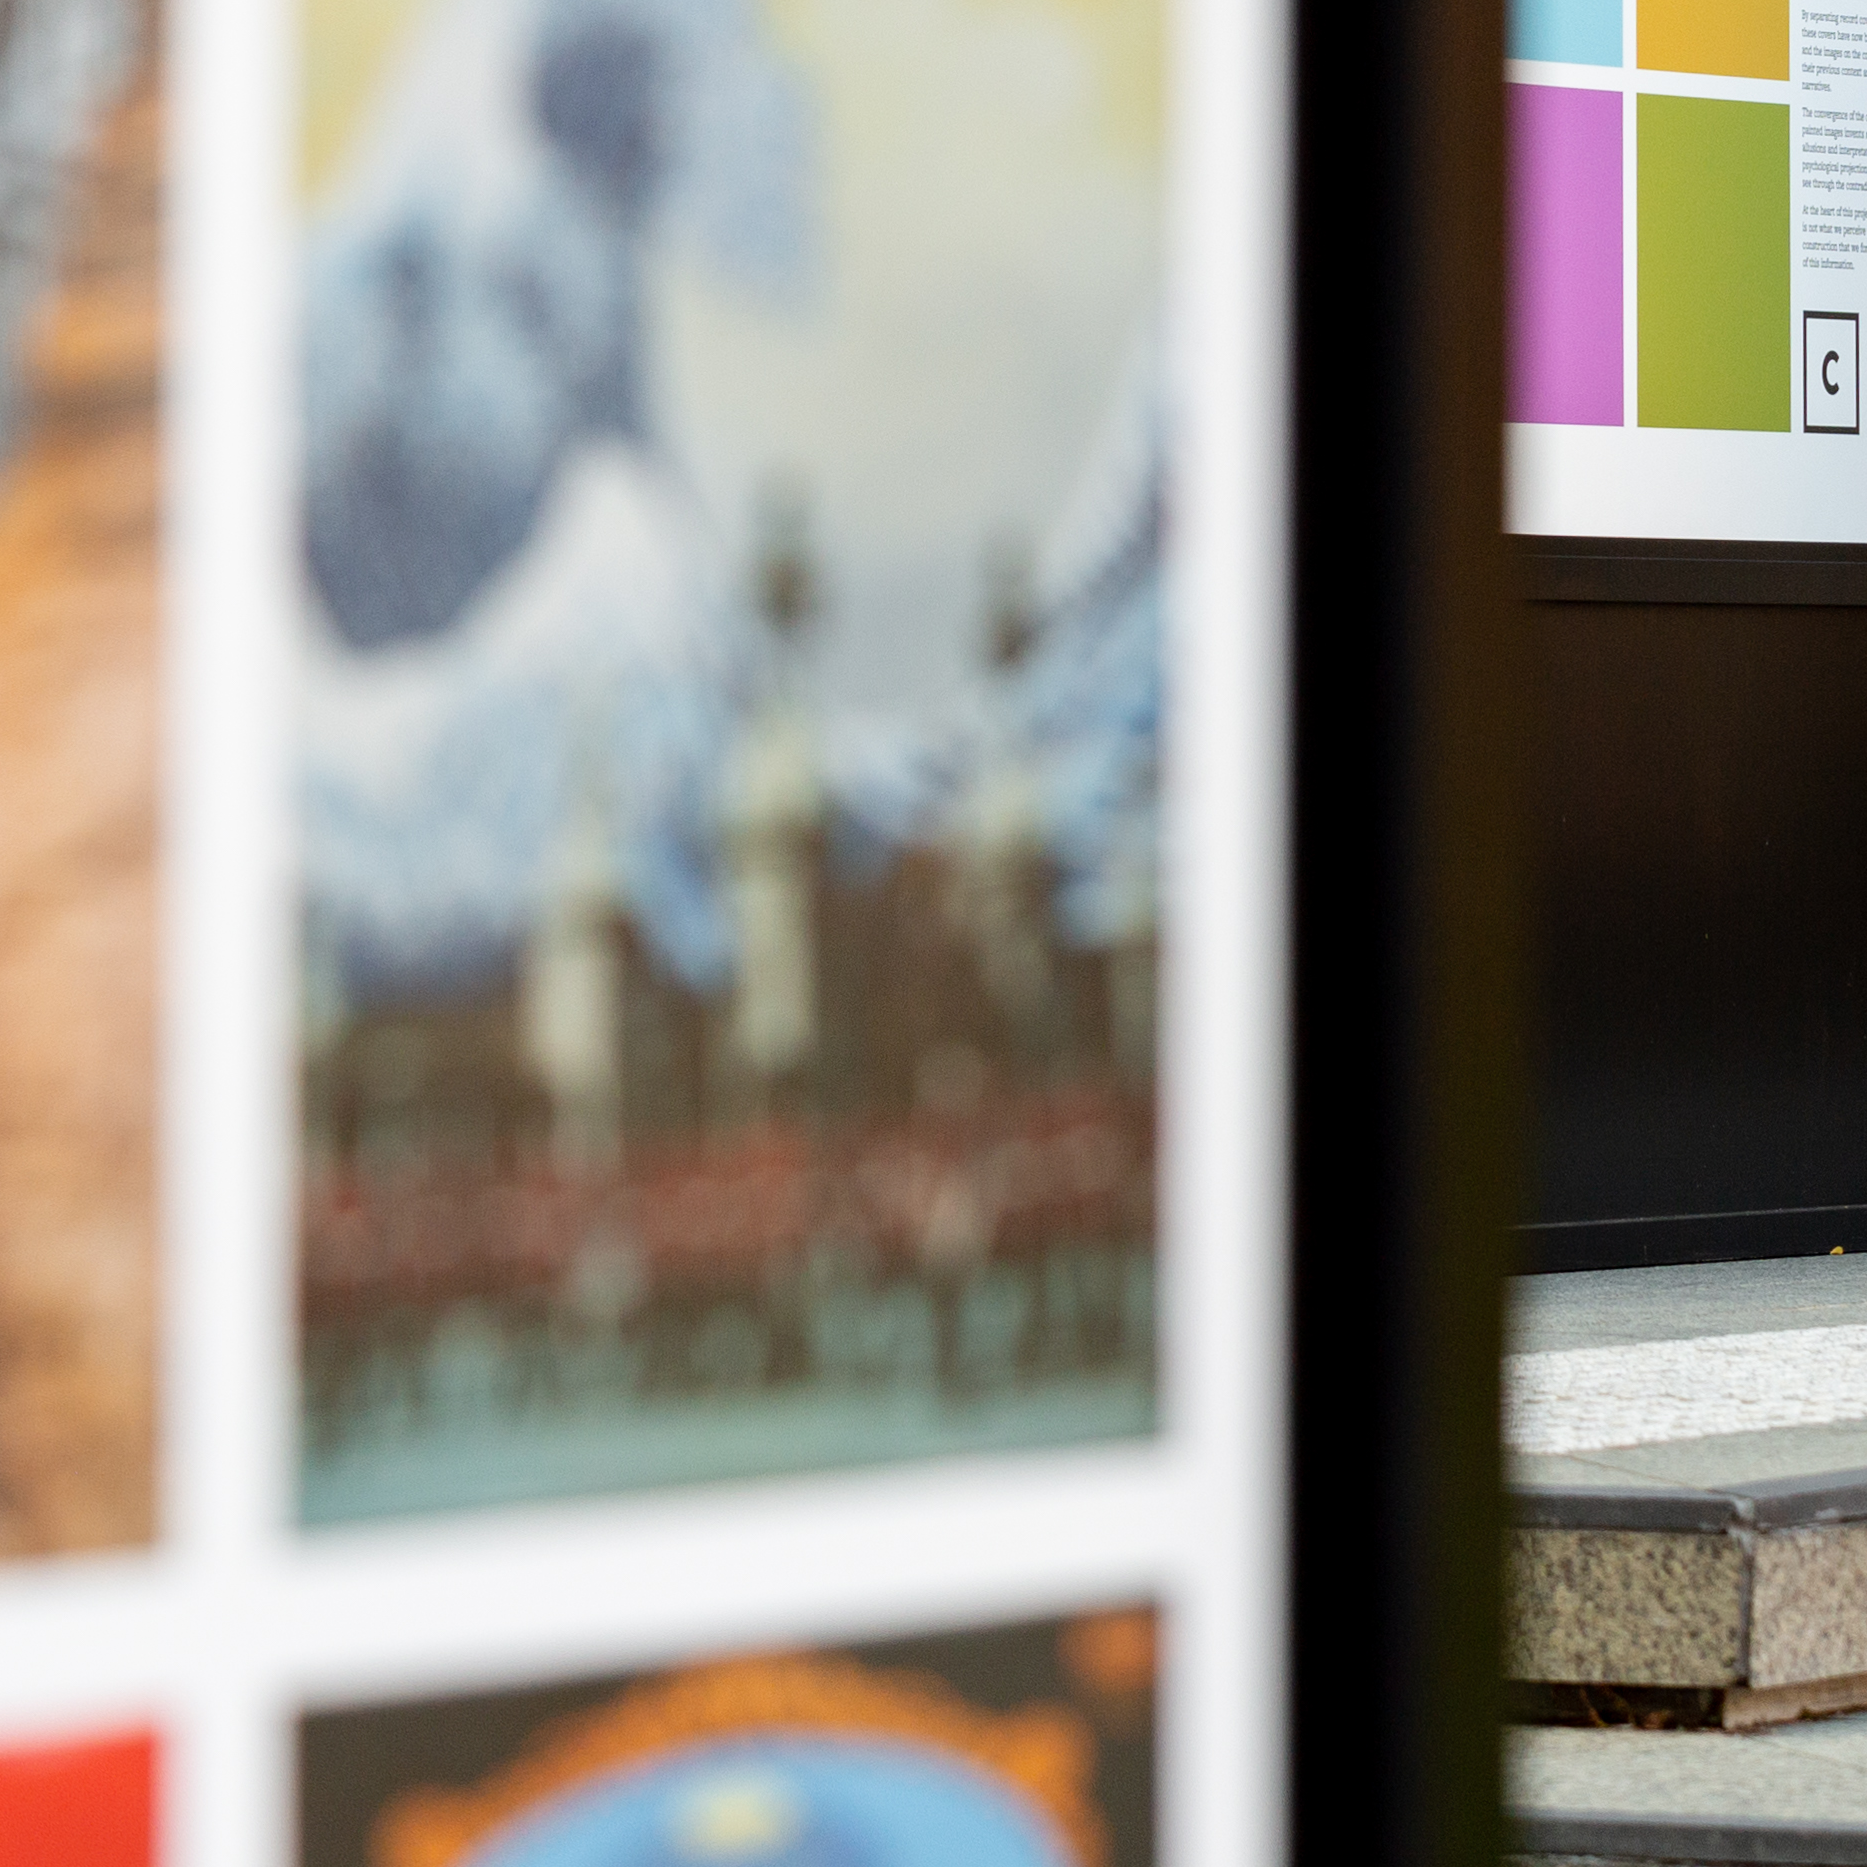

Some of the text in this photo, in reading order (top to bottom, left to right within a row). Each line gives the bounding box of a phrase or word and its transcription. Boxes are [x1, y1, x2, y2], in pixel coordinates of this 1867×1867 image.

[1810, 13, 1839, 27] separating
[1840, 14, 1858, 26] record
[1801, 27, 1817, 39] these
[1818, 31, 1836, 41] covers
[1823, 47, 1843, 61] images
[1801, 62, 1815, 74] their
[1816, 65, 1840, 77] previous
[1841, 67, 1862, 78] context
[1814, 110, 1848, 123] convergence
[1802, 126, 1823, 138] painted
[1824, 127, 1843, 141] images
[1844, 128, 1865, 140] invents
[1802, 142, 1826, 155] allusions
[1812, 178, 1835, 193] through
[1820, 206, 1835, 217] heart
[1843, 226, 1866, 238] perceive
[1802, 241, 1838, 252] construction
[1821, 350, 1840, 396] C
